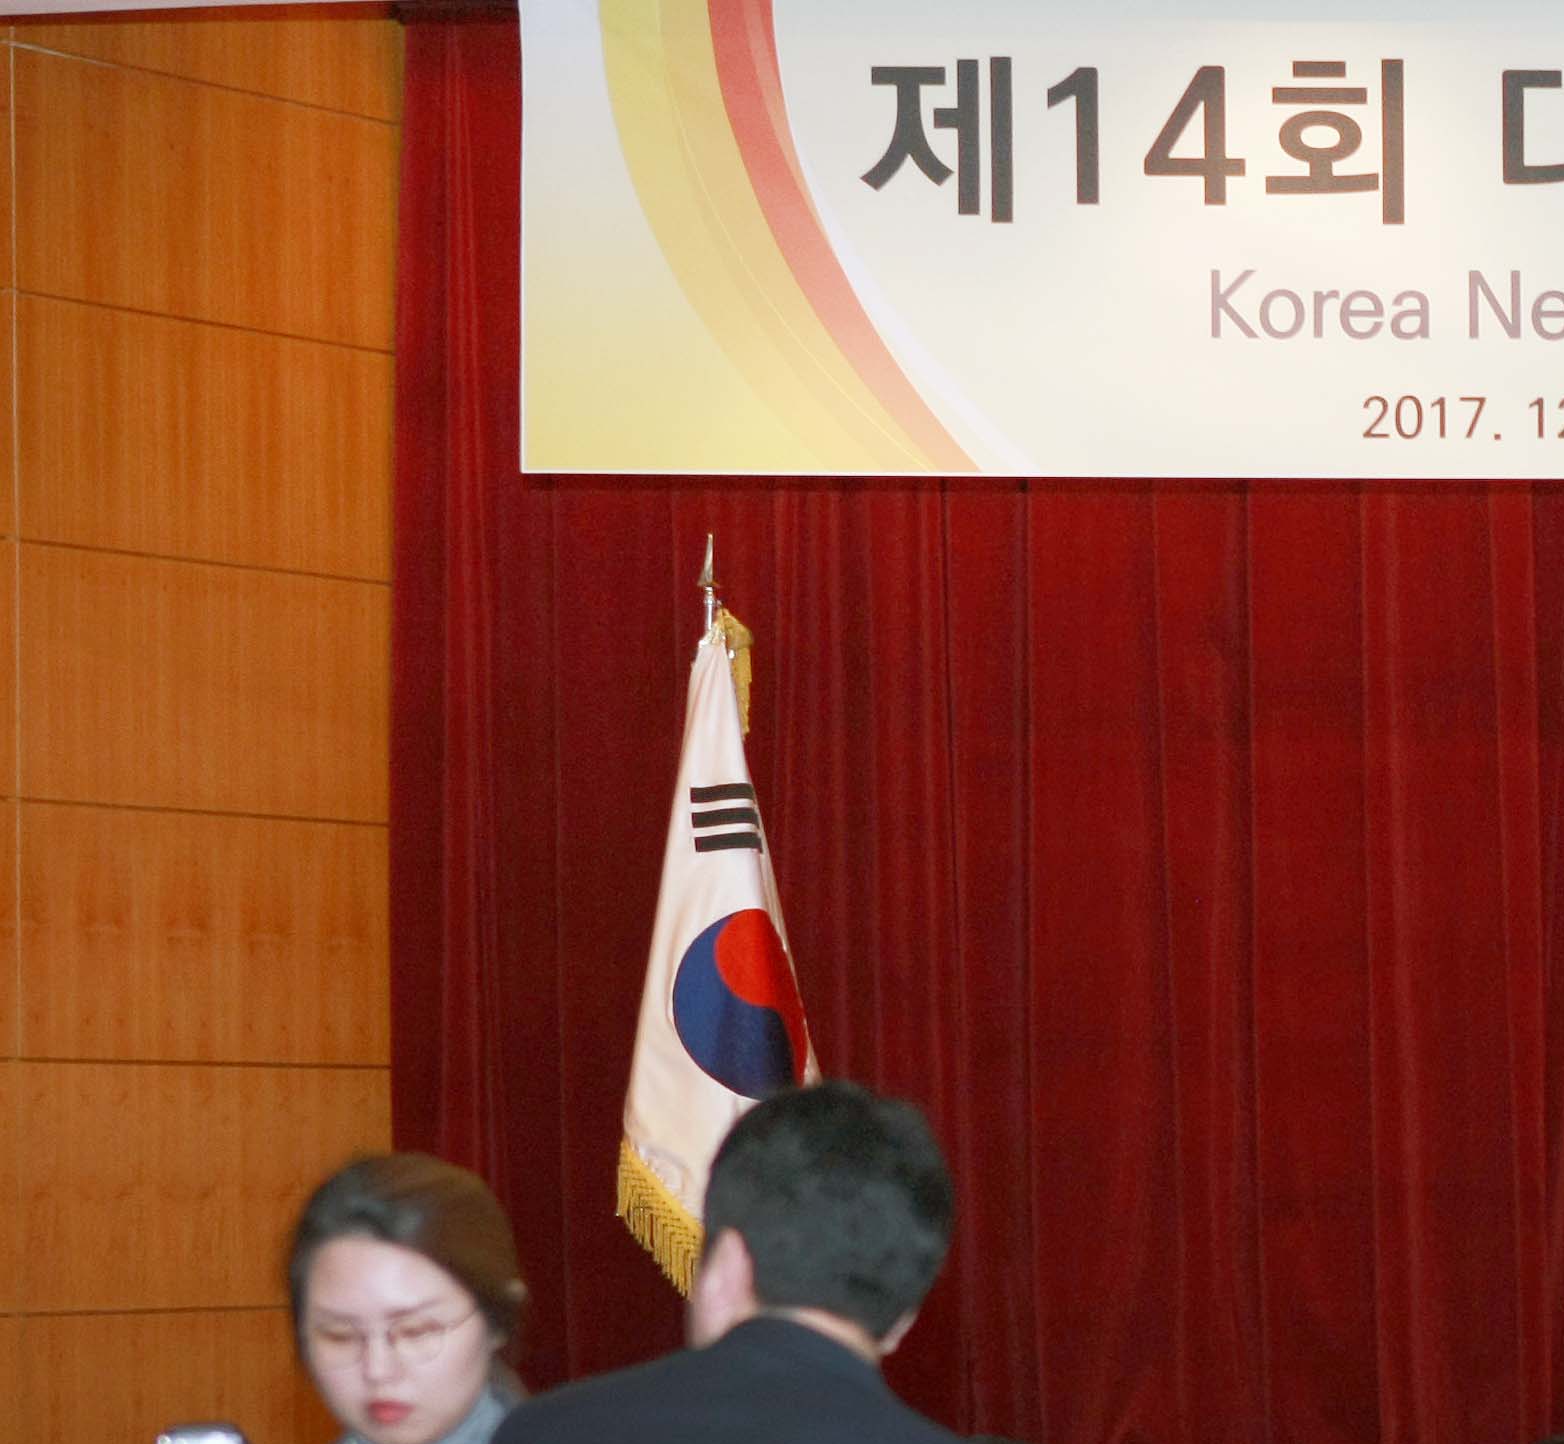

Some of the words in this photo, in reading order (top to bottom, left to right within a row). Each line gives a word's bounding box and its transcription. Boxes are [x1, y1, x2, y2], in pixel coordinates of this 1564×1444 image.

[861, 57, 1405, 225] 제14회
[1211, 270, 1430, 341] Korea
[1362, 395, 1502, 441] 2017.
